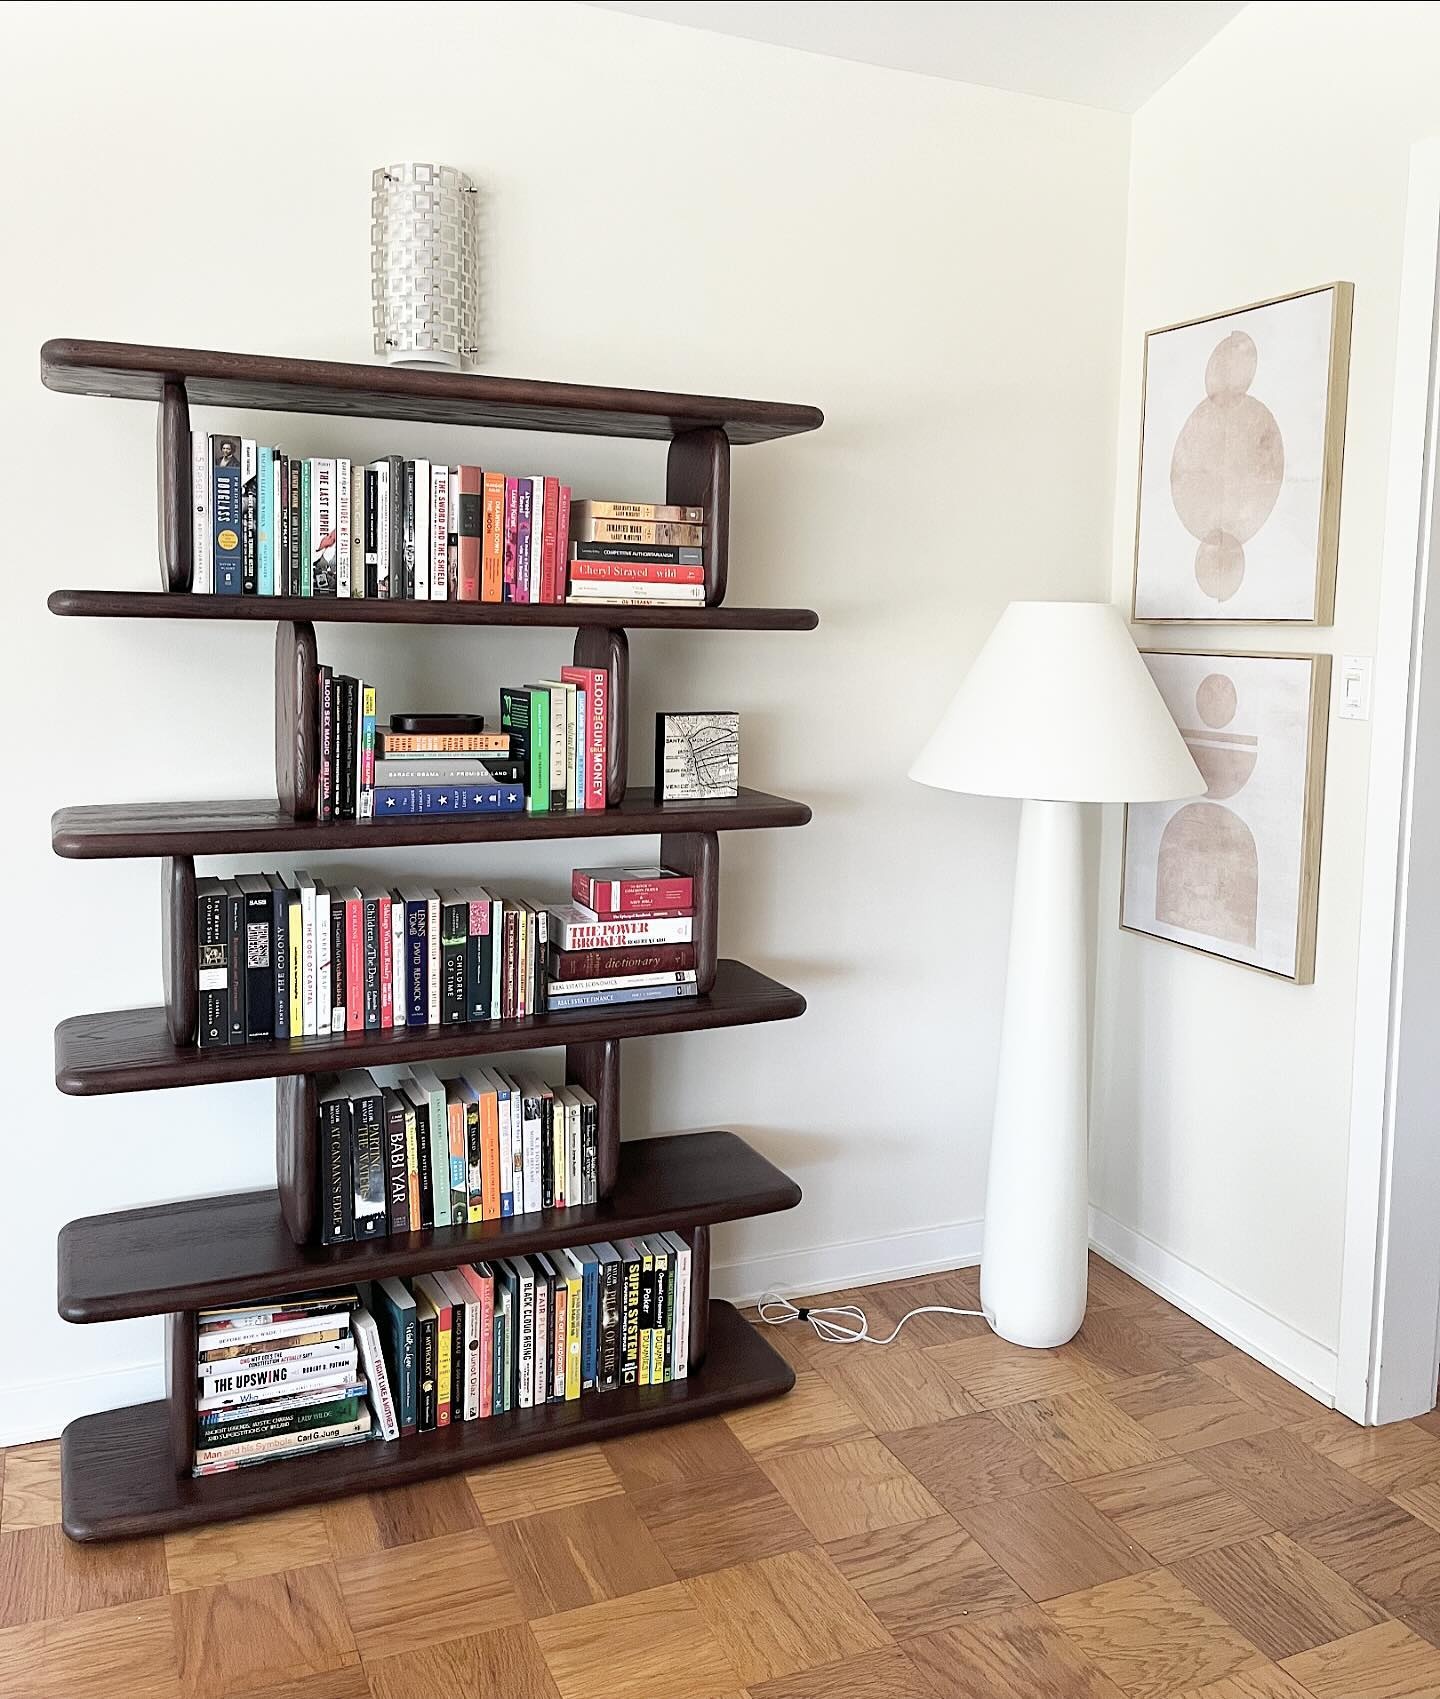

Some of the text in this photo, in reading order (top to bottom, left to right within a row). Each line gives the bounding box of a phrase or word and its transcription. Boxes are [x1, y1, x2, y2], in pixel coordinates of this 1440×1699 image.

[320, 471, 329, 485] THE
[216, 477, 231, 523] DOUGLASS
[320, 488, 329, 507] LAST
[320, 510, 329, 537] EMPIRE
[438, 480, 446, 586] THE SWORD AND THE SHIELD
[580, 566, 677, 579] Cheryl Strayed wild
[593, 674, 604, 796] BLOOD GUN MONEY
[388, 770, 414, 778] BARACK
[457, 769, 489, 777] PROMISED
[366, 903, 376, 942] Children
[382, 903, 391, 929] Siblings
[409, 913, 418, 936] TOMB
[417, 910, 426, 937] LENIN'S
[570, 922, 649, 938] THE POWER
[571, 935, 626, 949] BROKER
[248, 924, 259, 968] MODERNISM
[367, 950, 376, 967] The
[278, 926, 286, 993] THE COLONY
[306, 962, 313, 972] OF
[413, 942, 421, 1002] DAVID REMNICK
[447, 961, 454, 972] OF
[605, 956, 660, 970] dictionary
[366, 967, 376, 988] Days
[571, 997, 590, 1005] ESTATE
[590, 994, 614, 1003] FINANCE
[369, 1123, 381, 1172] PARTING
[358, 1125, 370, 1200] THE WATERS
[390, 1133, 406, 1204] BABI YAR
[331, 1126, 342, 1225] AT CANAAN'S EDGE
[523, 1282, 532, 1306] BLACK
[643, 1288, 651, 1313] Poker
[523, 1309, 532, 1334] CLOUD
[538, 1292, 546, 1340] FAIR PLAY
[627, 1263, 639, 1361] SUPER SYSTEM
[655, 1272, 665, 1371] Organic Chemistry DUMMIES
[404, 1322, 414, 1347] Walk
[605, 1290, 617, 1373] PILLAR OF FIRE
[523, 1336, 532, 1361] RISING
[302, 1360, 350, 1374] ROBERT PUTNAM
[374, 1359, 384, 1380] FIGHT
[470, 1352, 478, 1377] Junot
[214, 1367, 288, 1394] THE UPSWING
[378, 1381, 387, 1397] LIKE
[240, 1393, 259, 1403] Who
[204, 1427, 227, 1436] ANCIENT
[272, 1415, 294, 1424] CHARMS
[297, 1410, 333, 1423] LADY WILDE
[383, 1402, 394, 1429] MOTHER
[207, 1434, 219, 1442] AND
[270, 1421, 290, 1430] IRELAND
[297, 1428, 340, 1443] Carl Jung
[203, 1437, 293, 1460] Man and his Symbols
